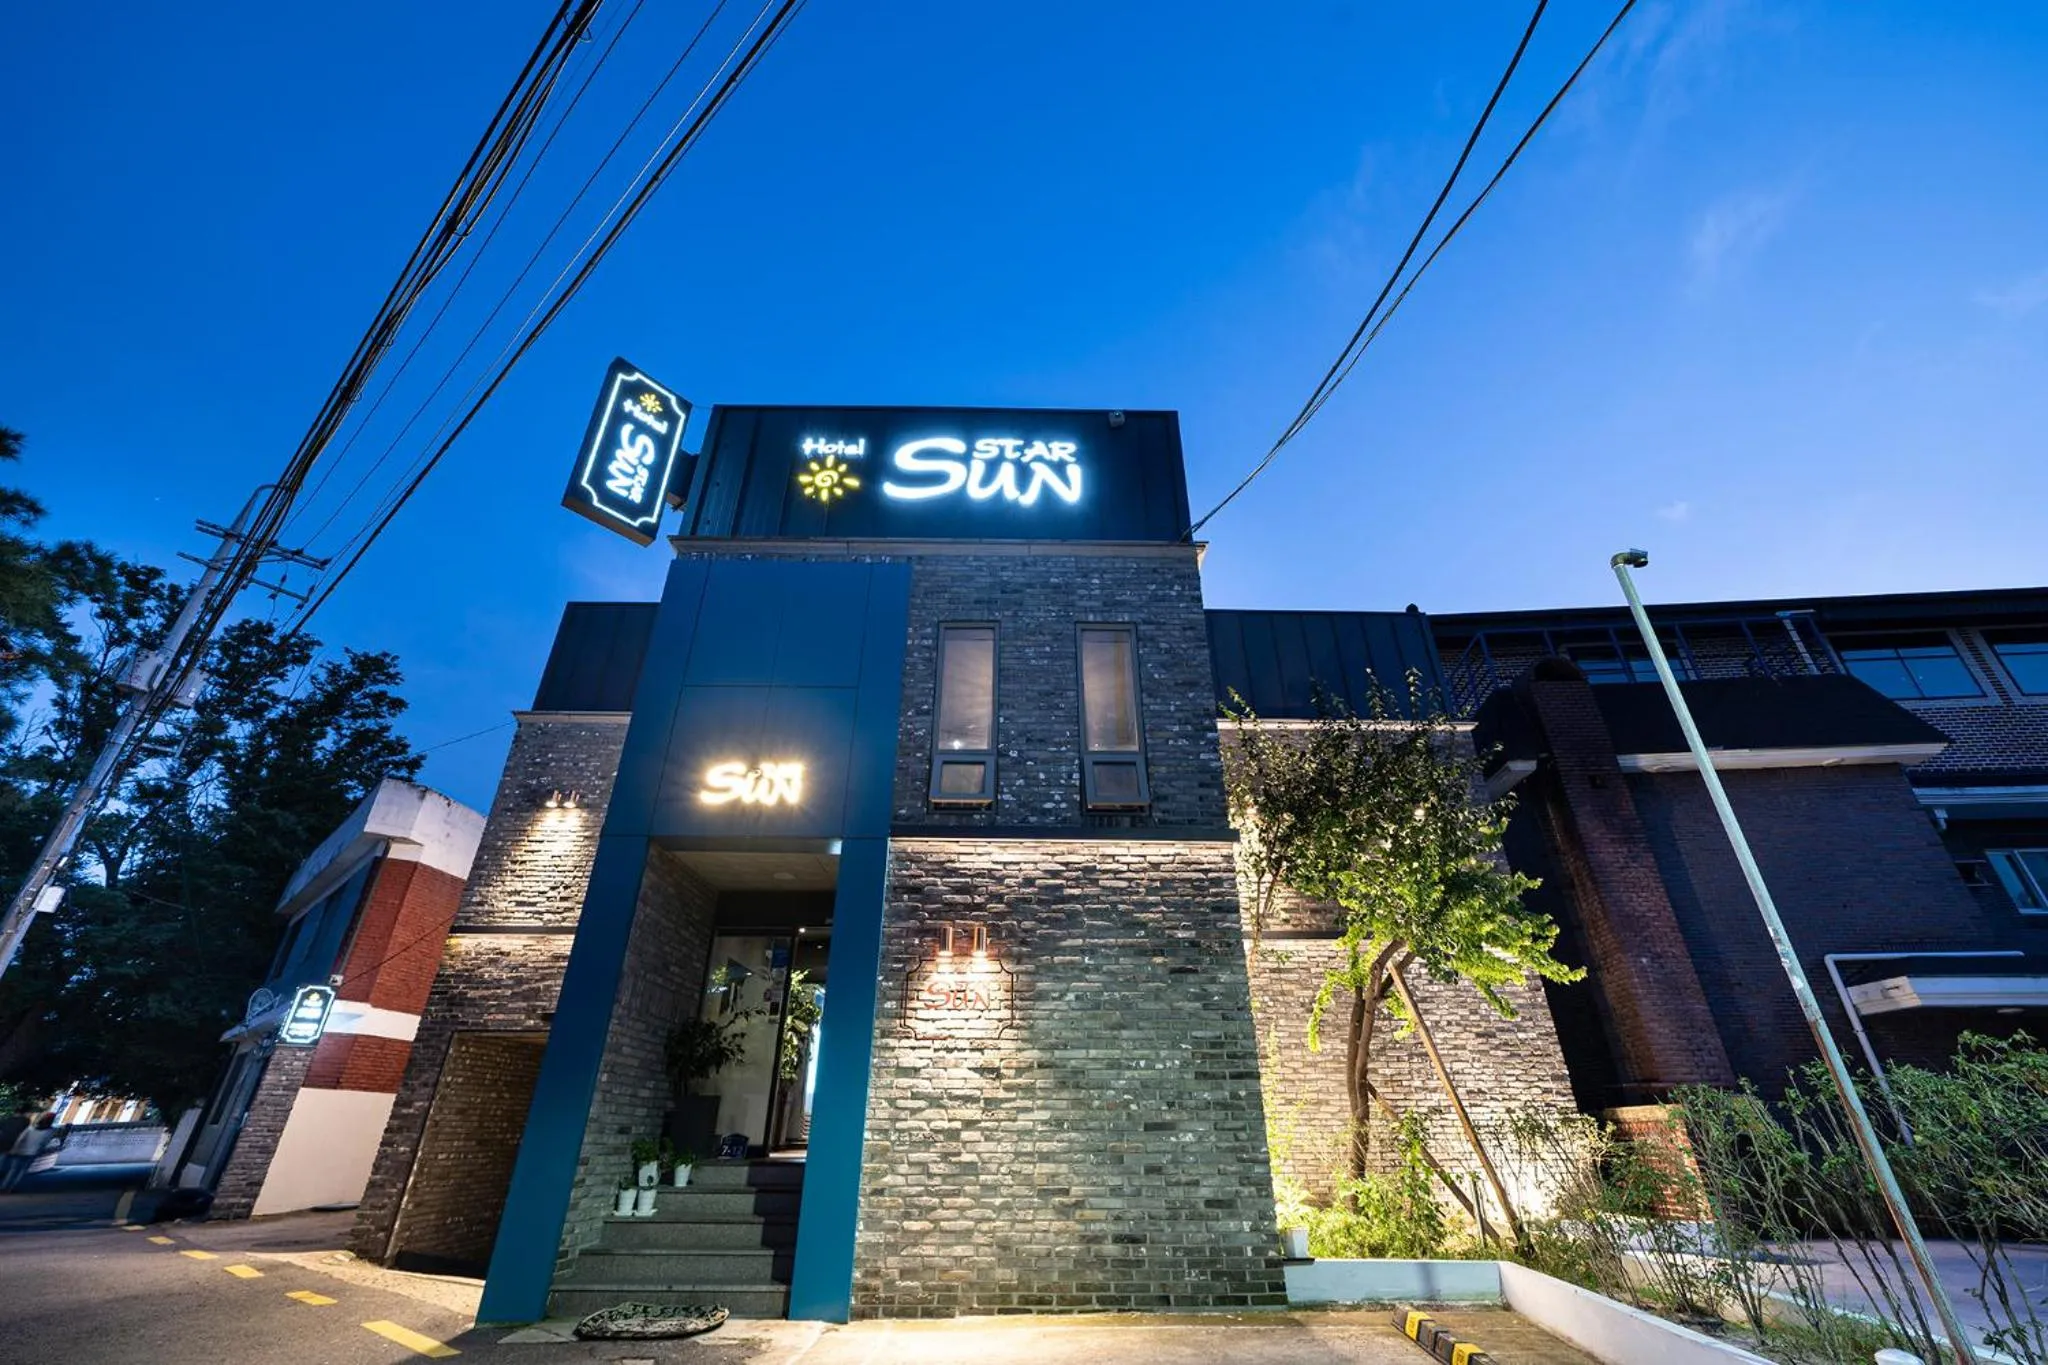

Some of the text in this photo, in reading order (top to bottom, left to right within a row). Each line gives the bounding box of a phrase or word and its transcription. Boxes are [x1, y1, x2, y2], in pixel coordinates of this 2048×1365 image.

[801, 436, 866, 456] Hotel
[972, 437, 1078, 462] STAR
[882, 437, 1082, 506] SUN
